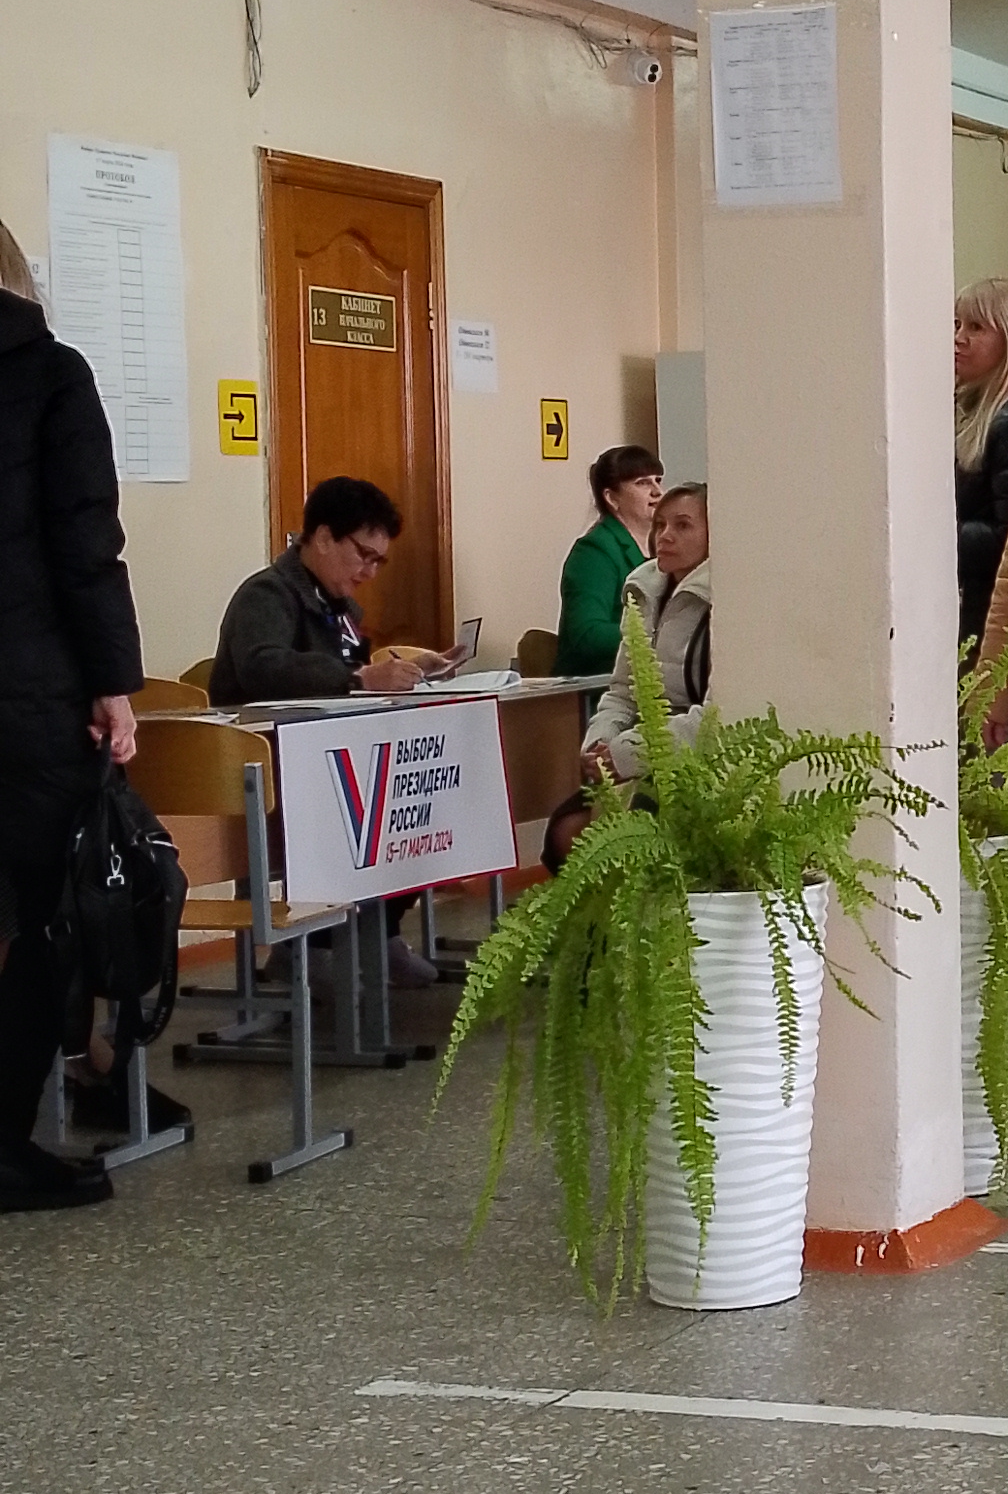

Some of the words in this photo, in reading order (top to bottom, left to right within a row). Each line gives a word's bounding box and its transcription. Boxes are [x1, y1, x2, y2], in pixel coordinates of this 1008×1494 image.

[313, 308, 327, 325] 13
[395, 734, 446, 765] ВЫБОРЫ
[392, 764, 460, 800] ПРЕЗИДЕНТА
[388, 802, 432, 834] РОССИИ
[407, 834, 433, 859] МАРТА
[433, 829, 453, 856] 2024
